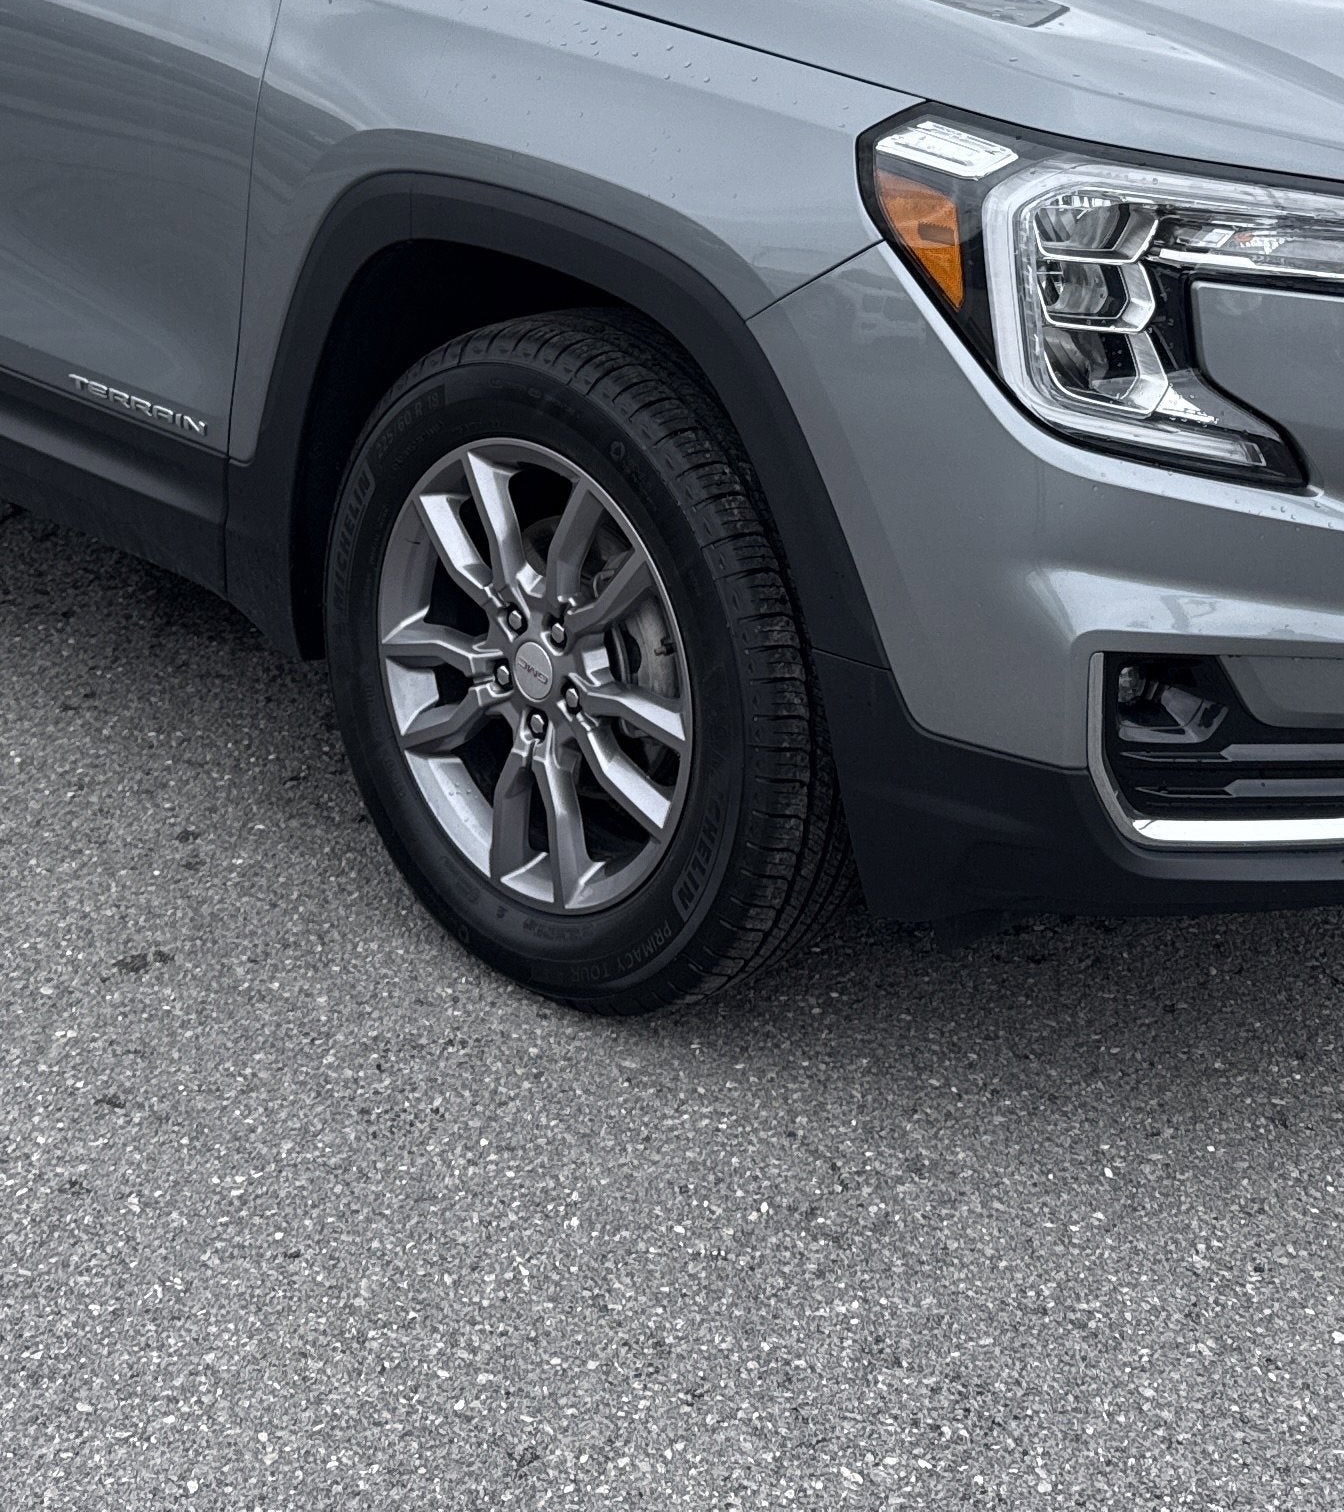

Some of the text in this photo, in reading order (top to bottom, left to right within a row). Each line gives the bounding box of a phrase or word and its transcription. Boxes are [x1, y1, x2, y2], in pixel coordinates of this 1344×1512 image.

[68, 373, 208, 437] TERRAIN
[331, 467, 375, 615] MICHELIN
[570, 961, 611, 982] TOUR
[615, 919, 673, 972] PRIMACY
